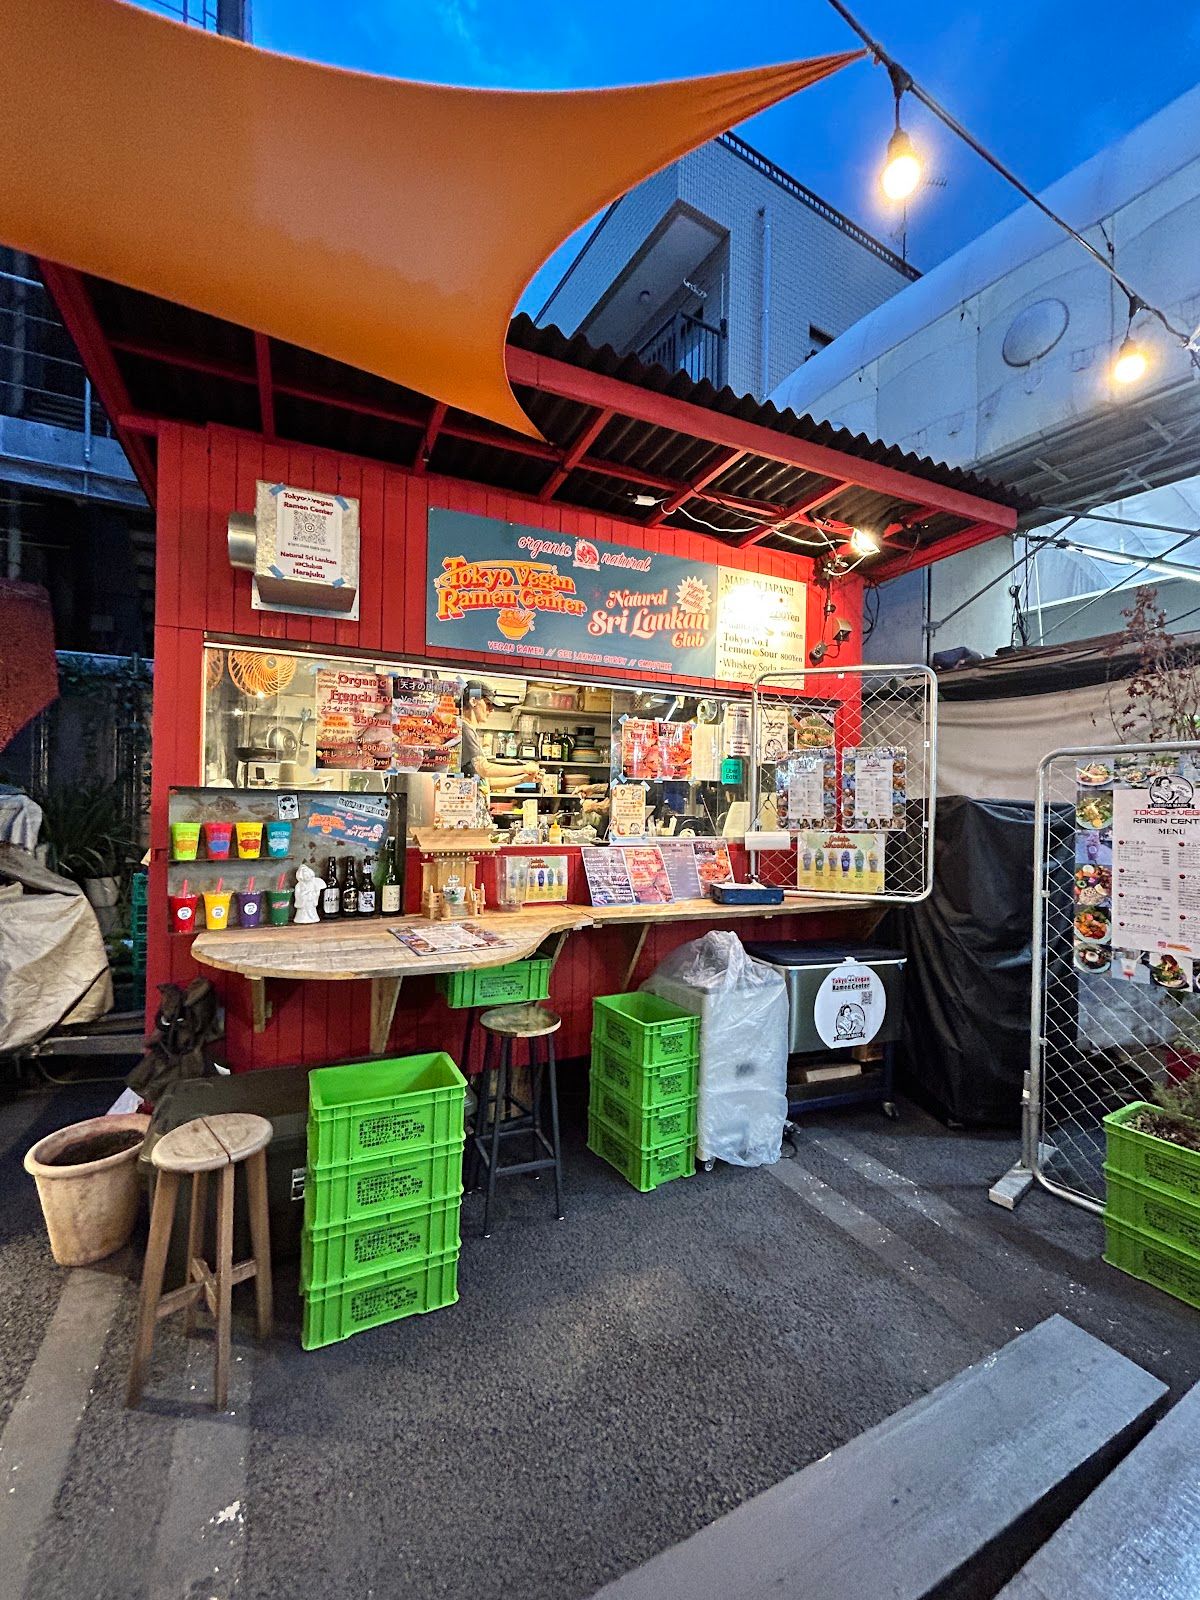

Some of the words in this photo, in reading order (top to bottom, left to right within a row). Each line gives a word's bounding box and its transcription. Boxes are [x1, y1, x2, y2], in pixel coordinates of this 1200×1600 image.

[283, 501, 308, 511] Ramen
[309, 506, 334, 516] Center
[518, 536, 572, 560] organic
[280, 551, 304, 560] Natural
[314, 556, 337, 565] Lankan
[600, 552, 651, 572] natural
[292, 568, 326, 579] Harajuku
[440, 556, 512, 593] Tokyo
[512, 566, 576, 595] Vegan
[436, 588, 518, 621] Ramen
[518, 588, 588, 617] Center
[605, 589, 669, 609] Natural
[587, 609, 630, 636] Sri
[629, 605, 710, 640] Lankan
[671, 631, 706, 648] Club
[487, 641, 515, 653] VEGAN
[516, 644, 545, 656] RAMEN
[557, 649, 573, 659] SRI
[573, 650, 603, 662] LANKAN
[723, 643, 752, 656] Lemon
[759, 648, 779, 659] Sour
[722, 657, 757, 672] Whiskey
[758, 662, 777, 672] Soda
[330, 689, 372, 703] French
[832, 983, 852, 992] Ramen
[851, 982, 870, 990] Center
